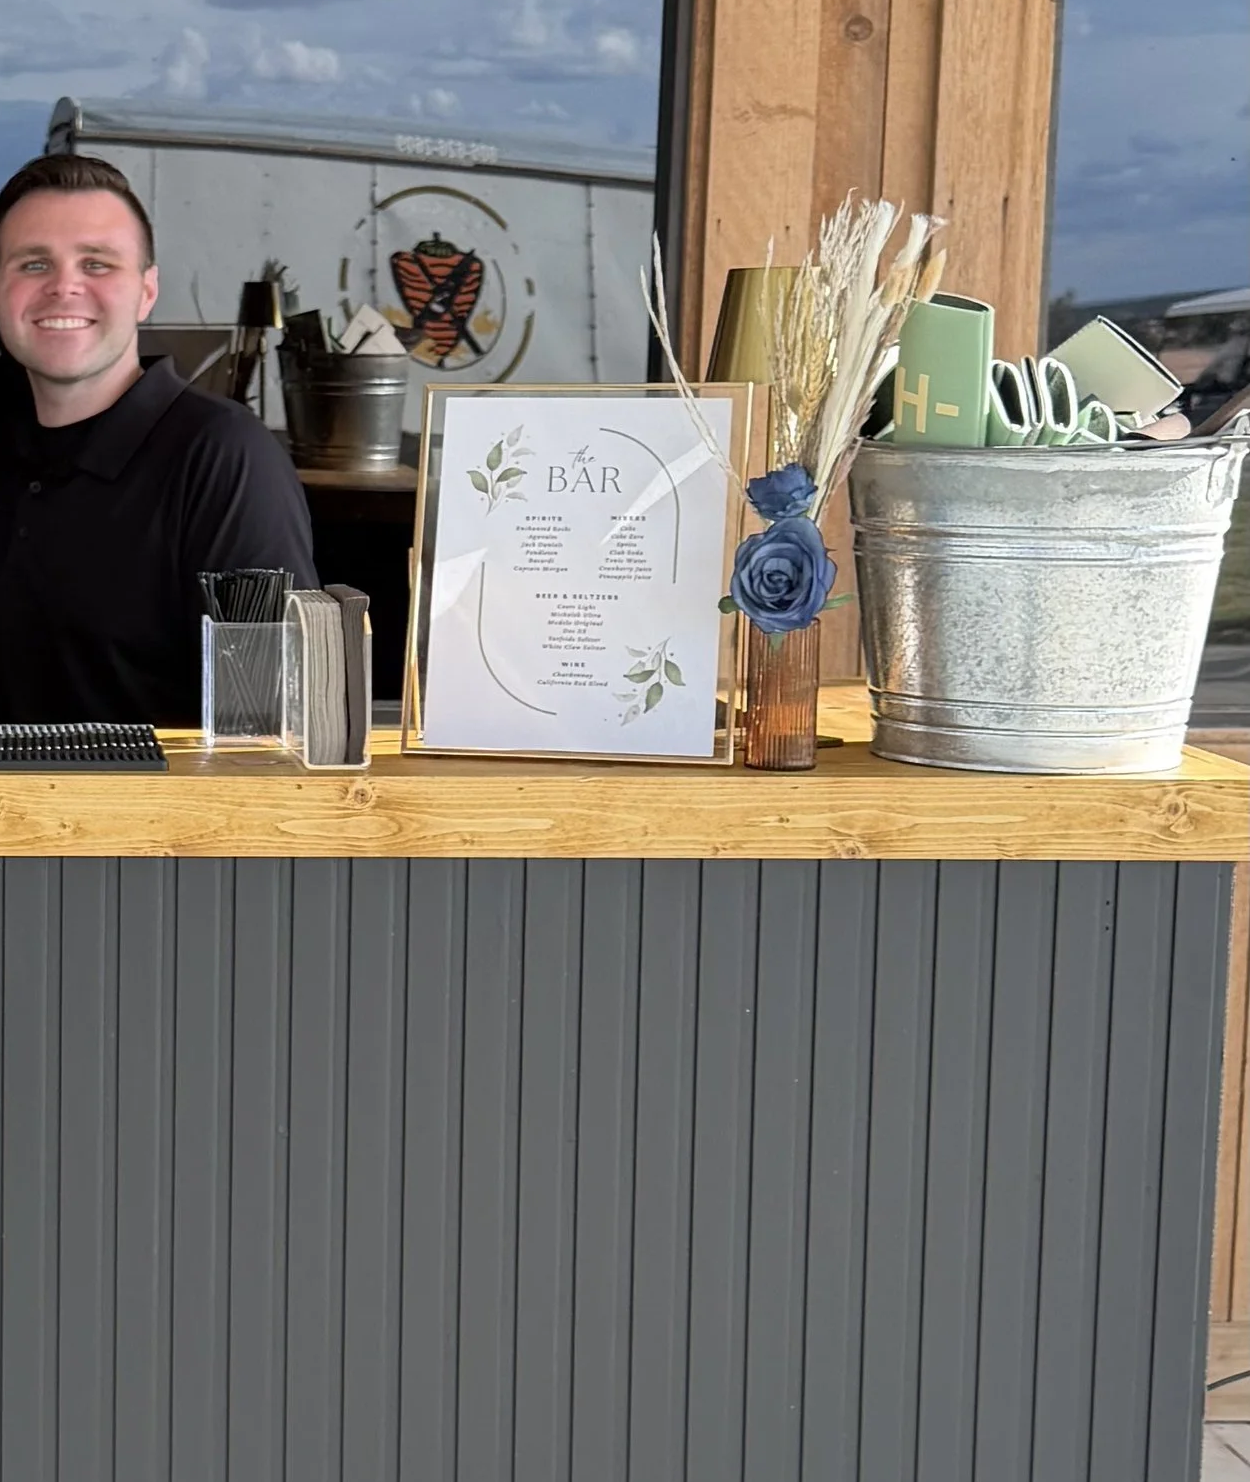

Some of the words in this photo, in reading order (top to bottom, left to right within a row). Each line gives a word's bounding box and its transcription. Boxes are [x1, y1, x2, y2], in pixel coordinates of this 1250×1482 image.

[568, 445, 597, 470] the
[547, 465, 622, 494] BAR
[520, 541, 536, 549] Jack
[513, 565, 540, 573] Captain
[552, 671, 594, 679] Chardonnay
[536, 679, 572, 687] California
